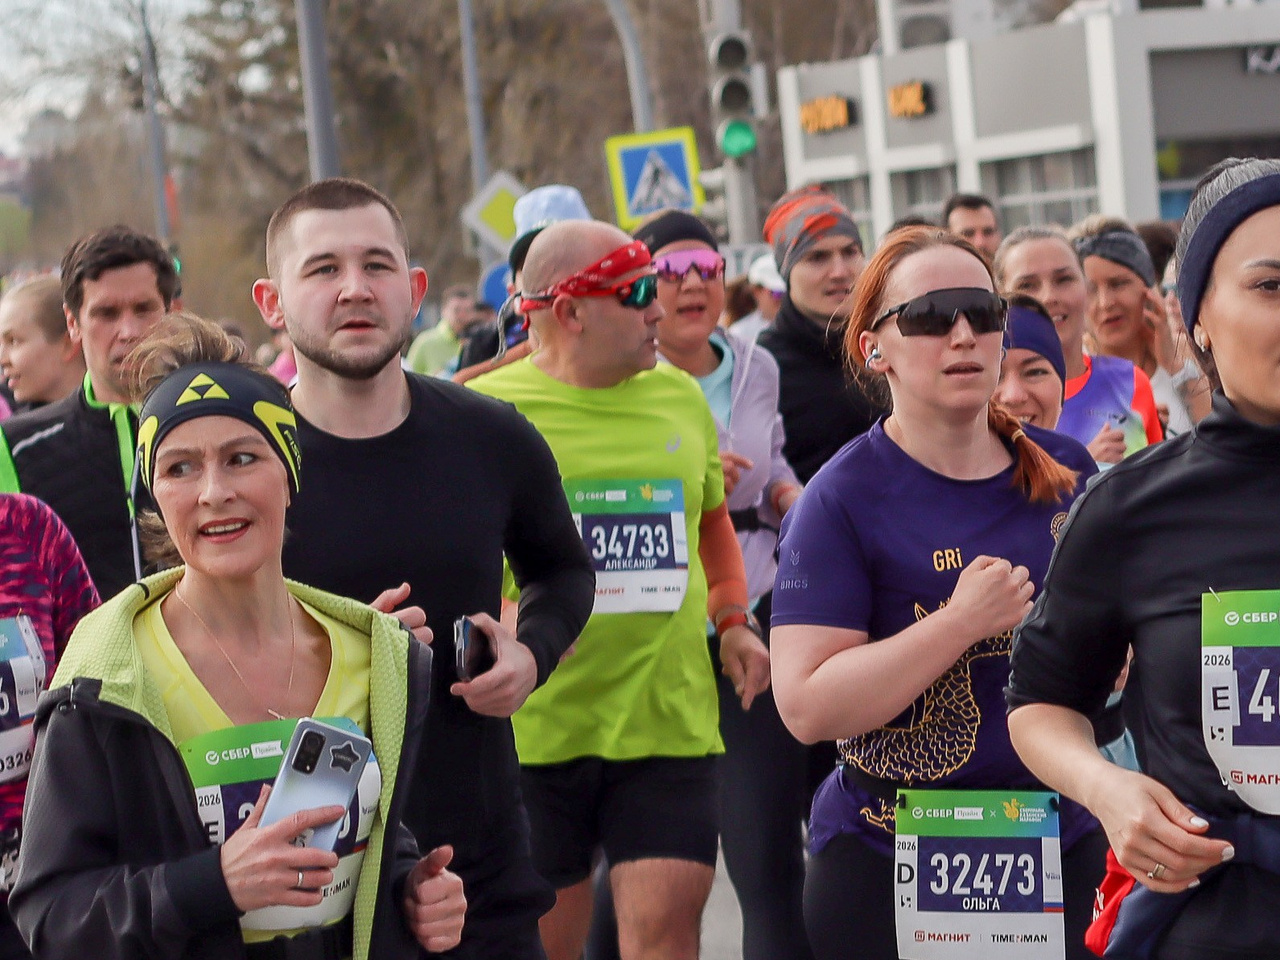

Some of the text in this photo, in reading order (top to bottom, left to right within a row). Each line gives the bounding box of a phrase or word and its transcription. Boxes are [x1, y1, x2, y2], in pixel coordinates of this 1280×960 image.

[591, 524, 669, 559] 34733
[604, 558, 658, 571] АЛЕКСАНДР
[780, 579, 808, 590] BRICS
[1242, 611, 1278, 623] СБЕР
[1203, 654, 1231, 666] 2026
[1211, 686, 1231, 711] E
[221, 747, 250, 761] СБЕР
[198, 793, 221, 807] 2026
[925, 808, 953, 818] СБЕР
[896, 841, 917, 851] 2026
[897, 862, 915, 885] D
[929, 852, 1035, 896] 32473
[962, 897, 1001, 911] ОЛЬГА
[927, 933, 971, 942] МАГНИТ
